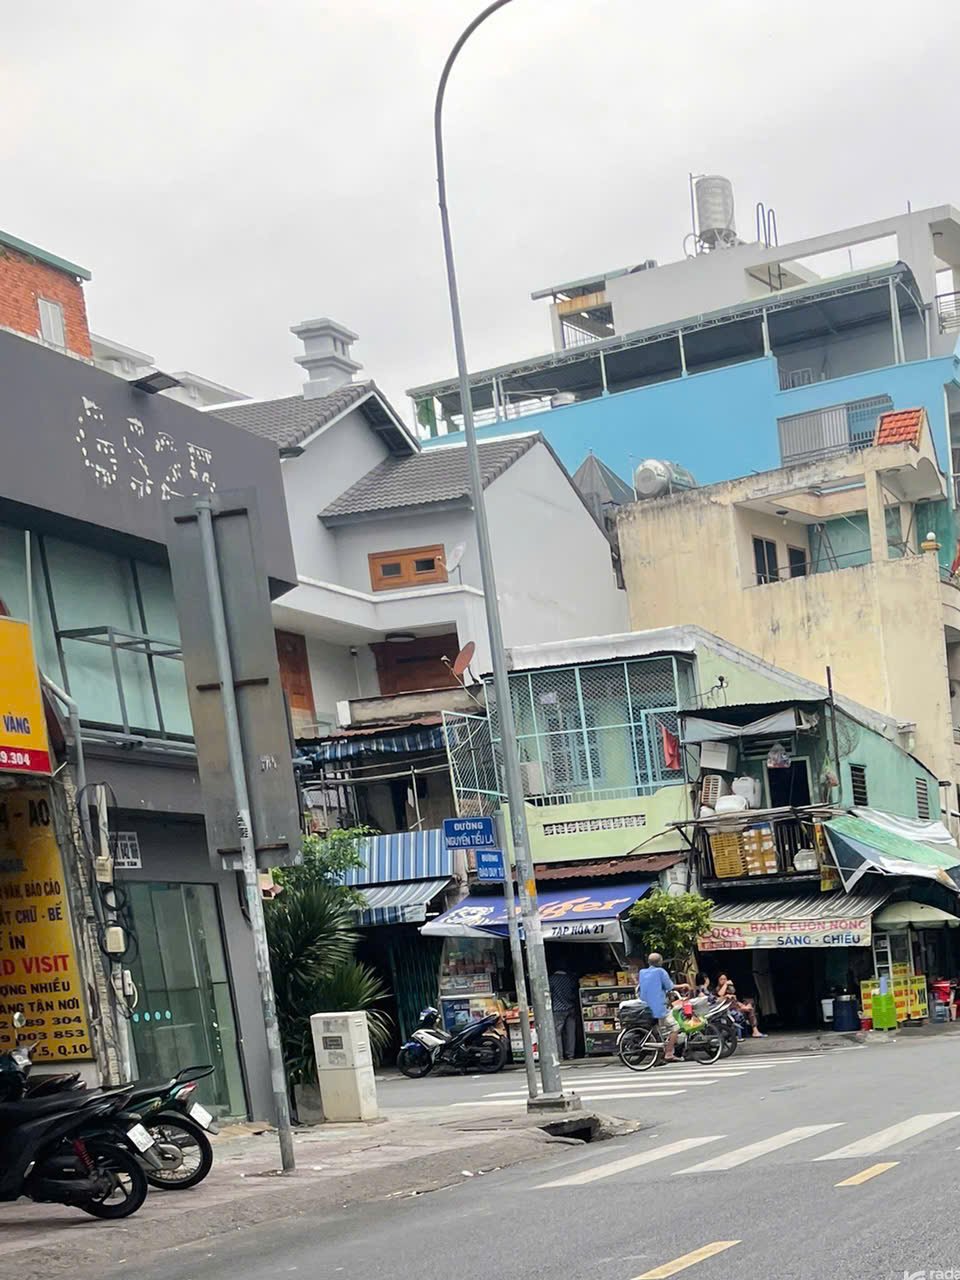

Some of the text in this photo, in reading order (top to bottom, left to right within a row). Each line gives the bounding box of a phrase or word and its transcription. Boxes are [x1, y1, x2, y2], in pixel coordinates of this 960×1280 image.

[3, 711, 31, 734] VÀNG
[777, 933, 811, 945] SÁNG
[23, 954, 69, 973] VISIT
[28, 999, 54, 1013] TẬN
[52, 1016, 82, 1025] 304
[53, 1030, 85, 1039] 853
